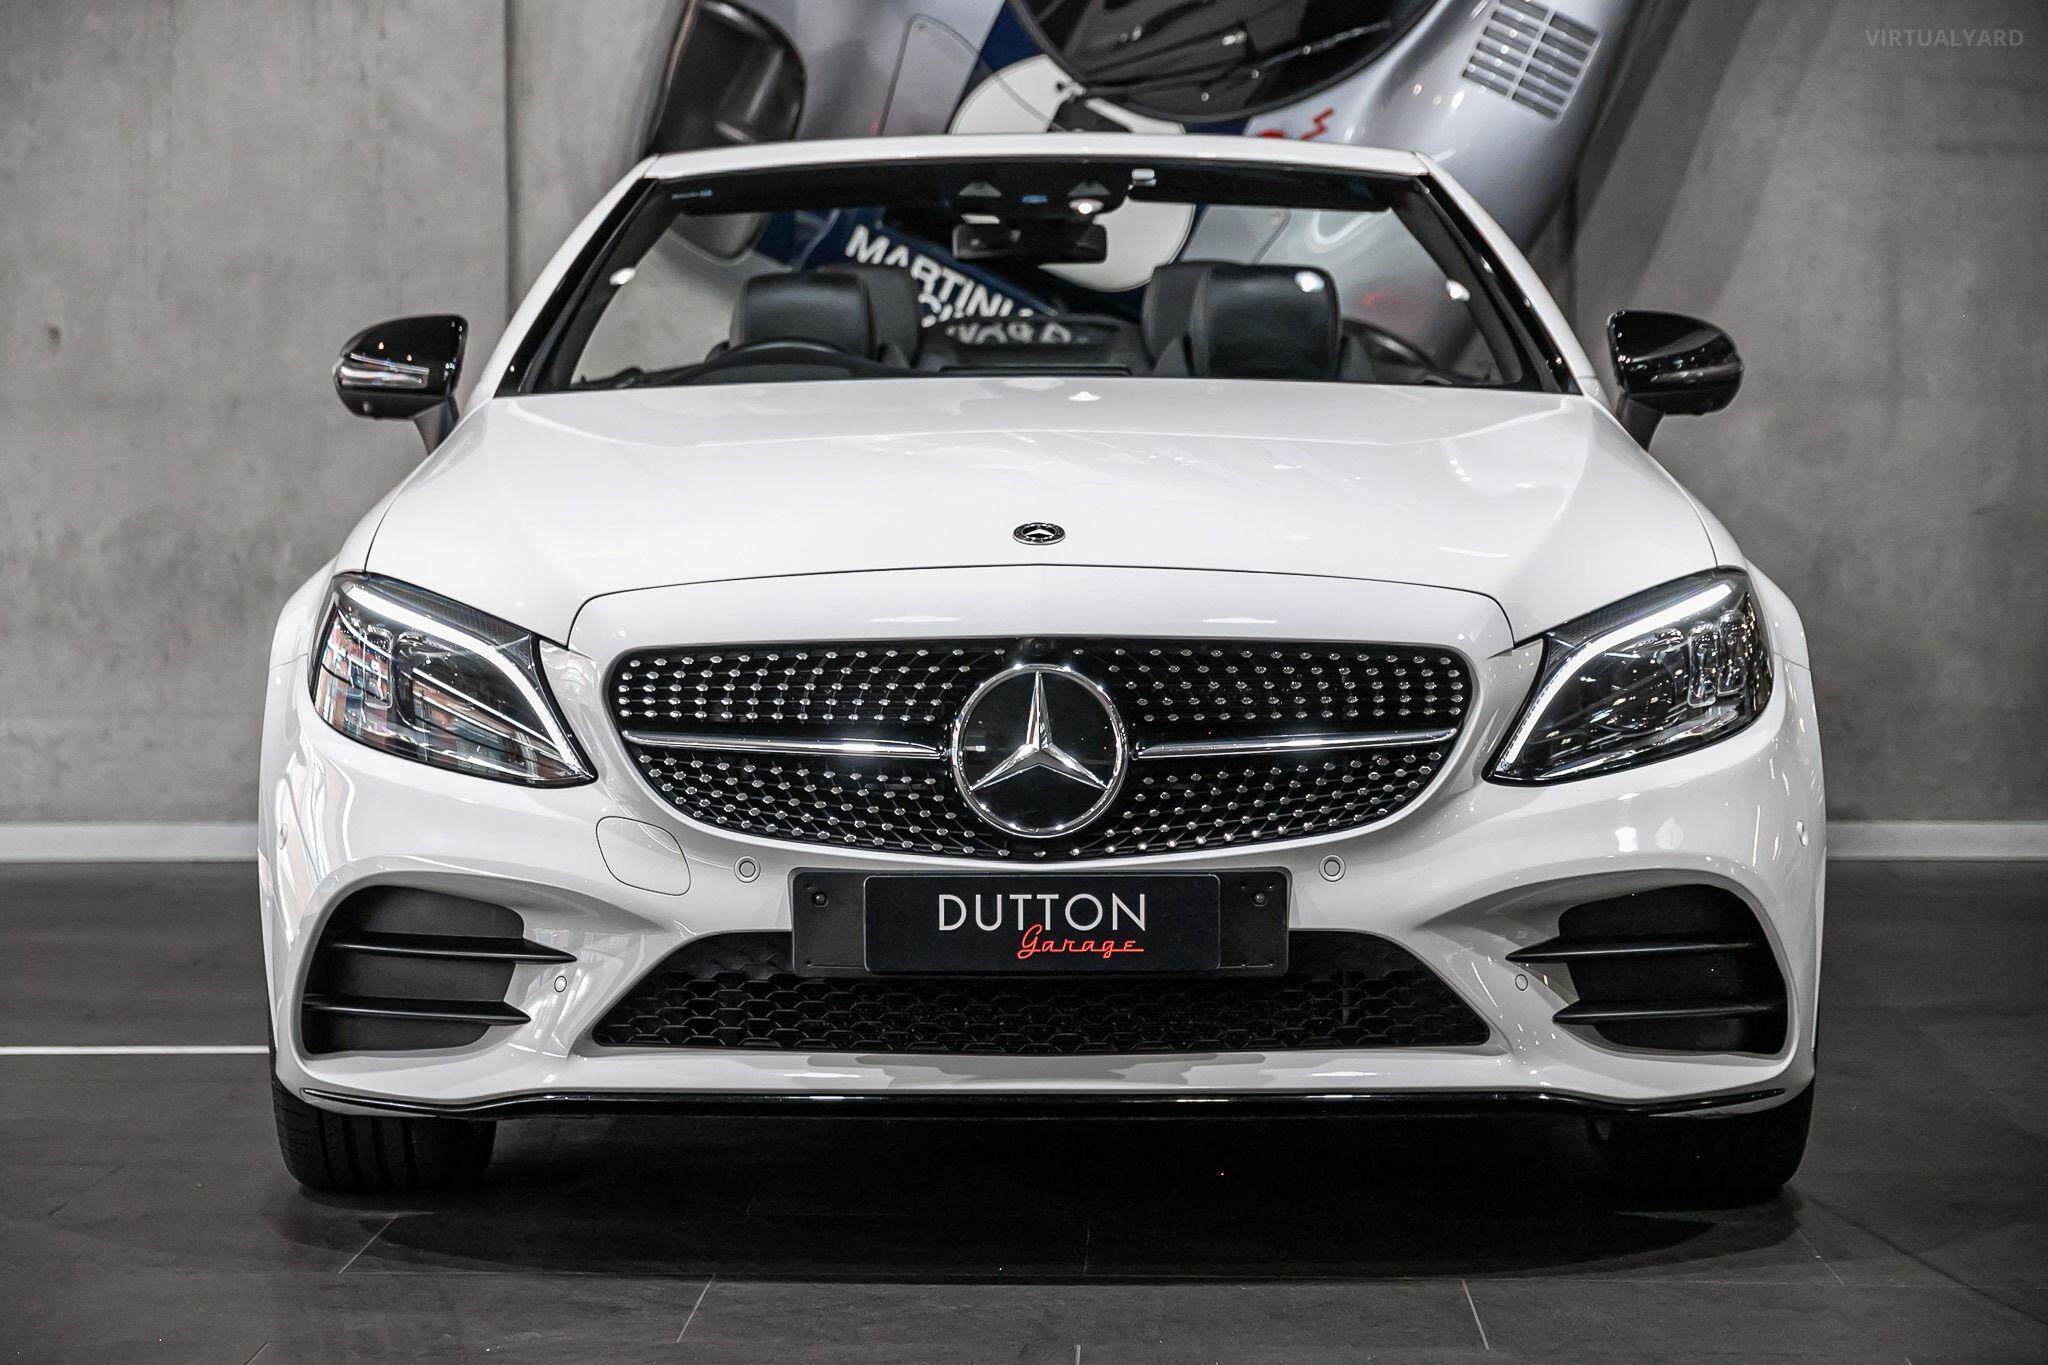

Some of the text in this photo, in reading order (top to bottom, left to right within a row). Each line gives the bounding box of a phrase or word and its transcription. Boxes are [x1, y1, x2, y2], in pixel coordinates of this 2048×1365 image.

[845, 223, 1014, 318] MARTINI
[938, 893, 1146, 932] DUTTON
[1016, 923, 1145, 960] Garage
